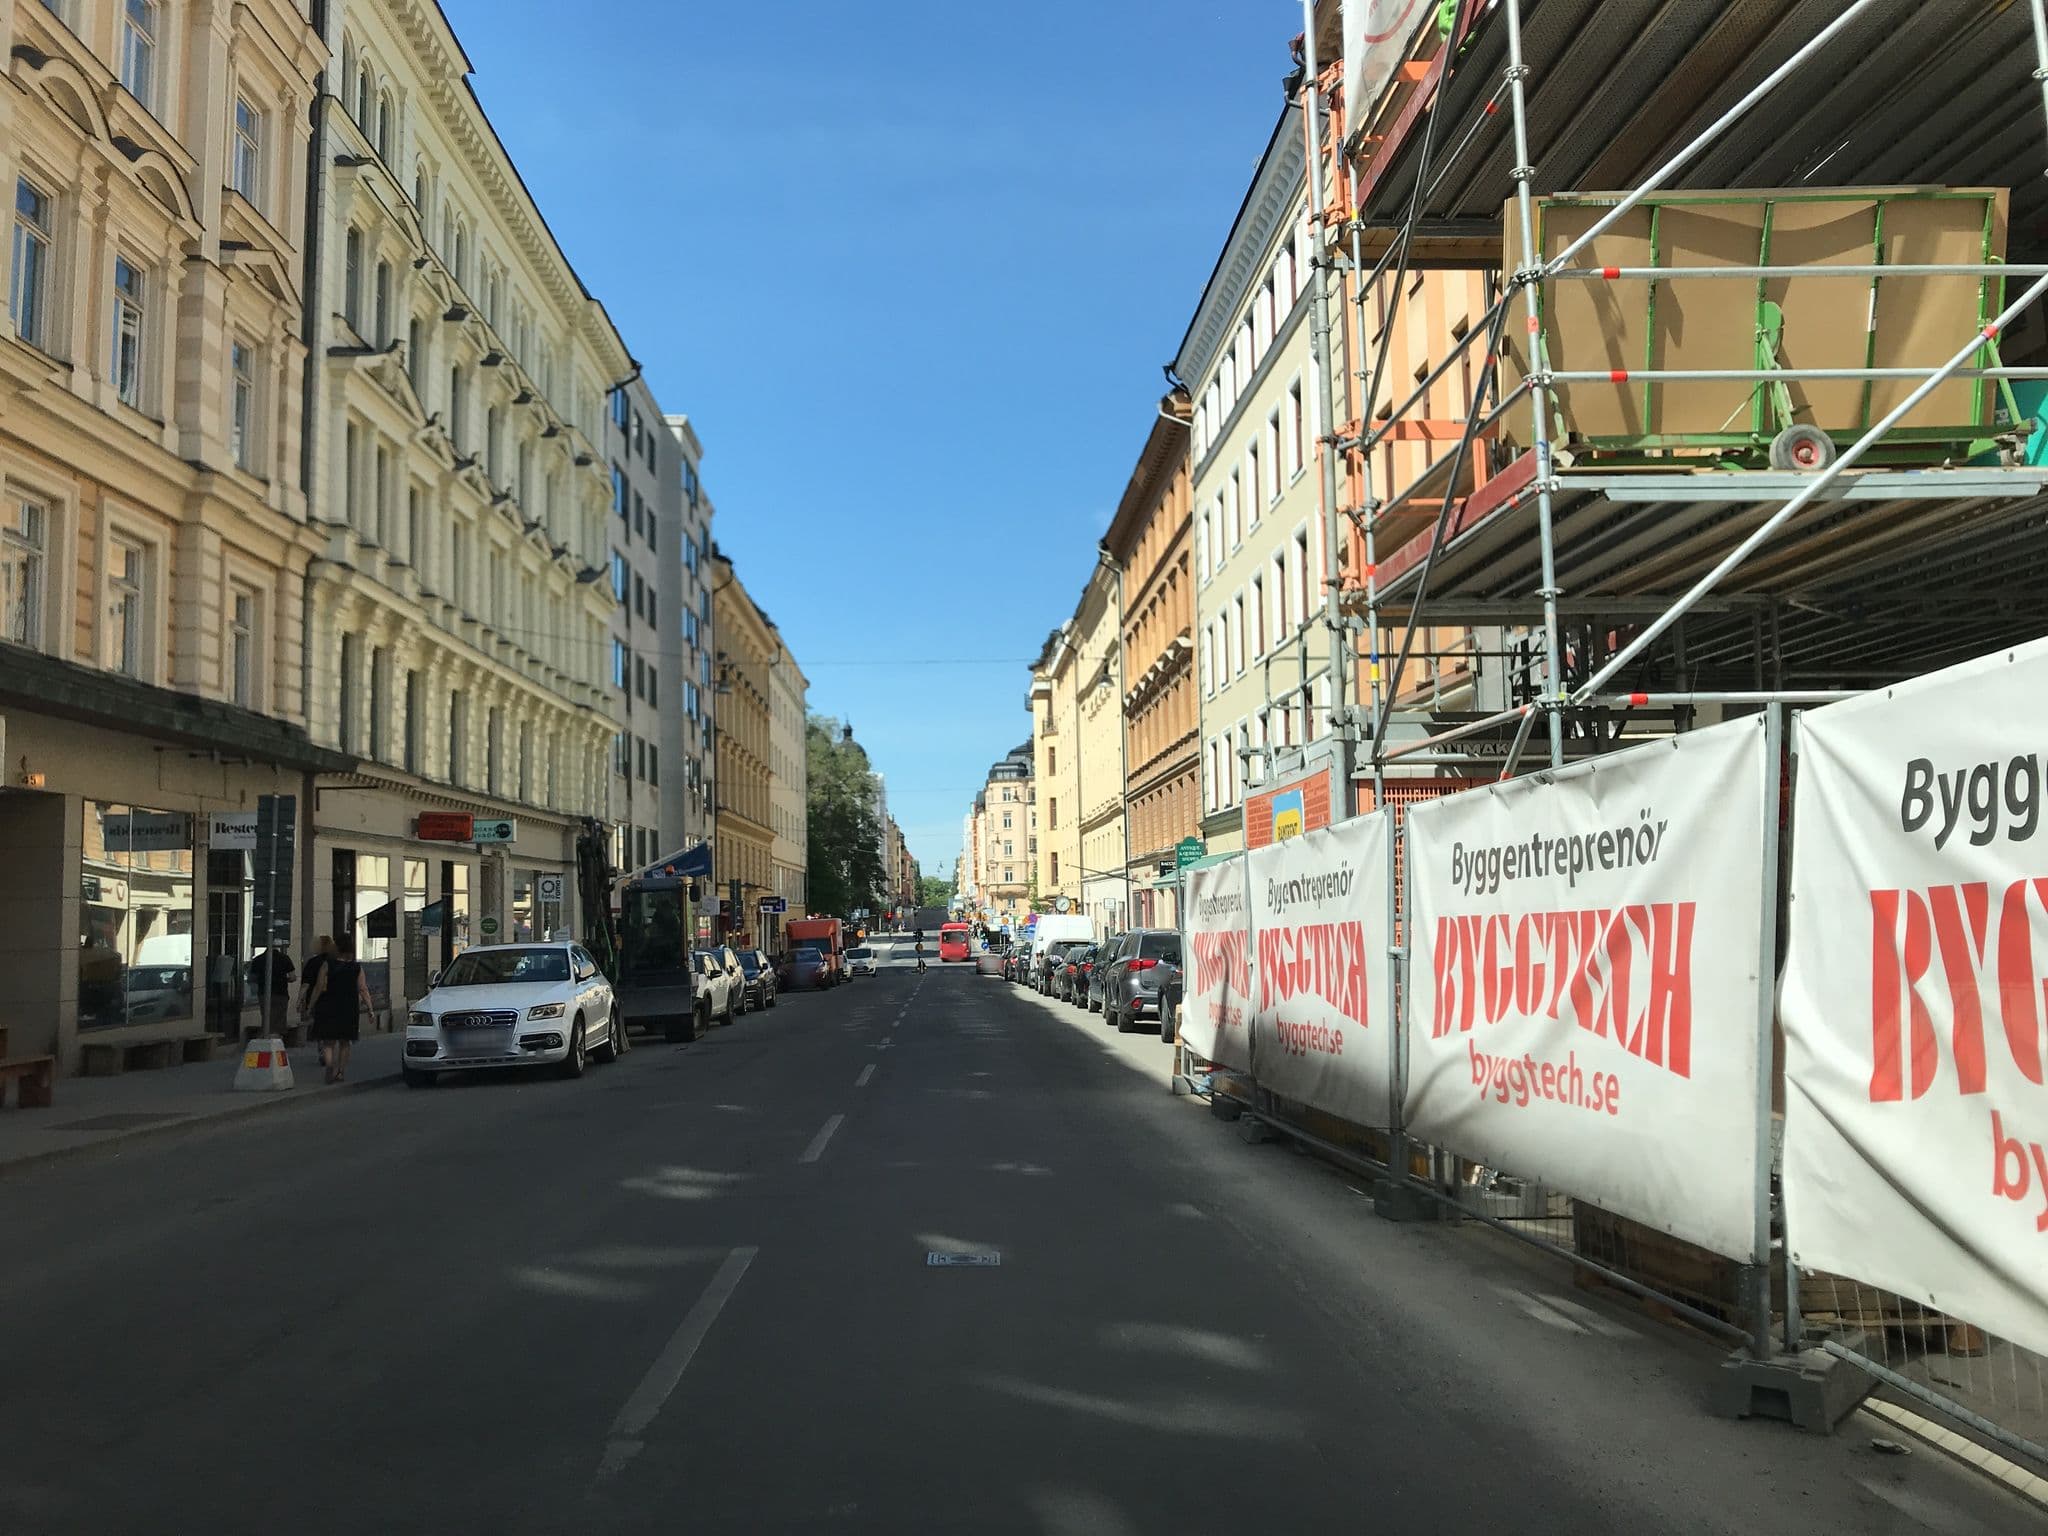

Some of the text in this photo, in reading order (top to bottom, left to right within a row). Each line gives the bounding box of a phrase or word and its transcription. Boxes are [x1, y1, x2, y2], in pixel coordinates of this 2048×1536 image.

[1903, 752, 2048, 851] Bygg
[1452, 806, 1668, 896] Byggentreprenör
[1431, 901, 1697, 1079] BYGGTECH
[1469, 1037, 1620, 1116] byggtech.se
